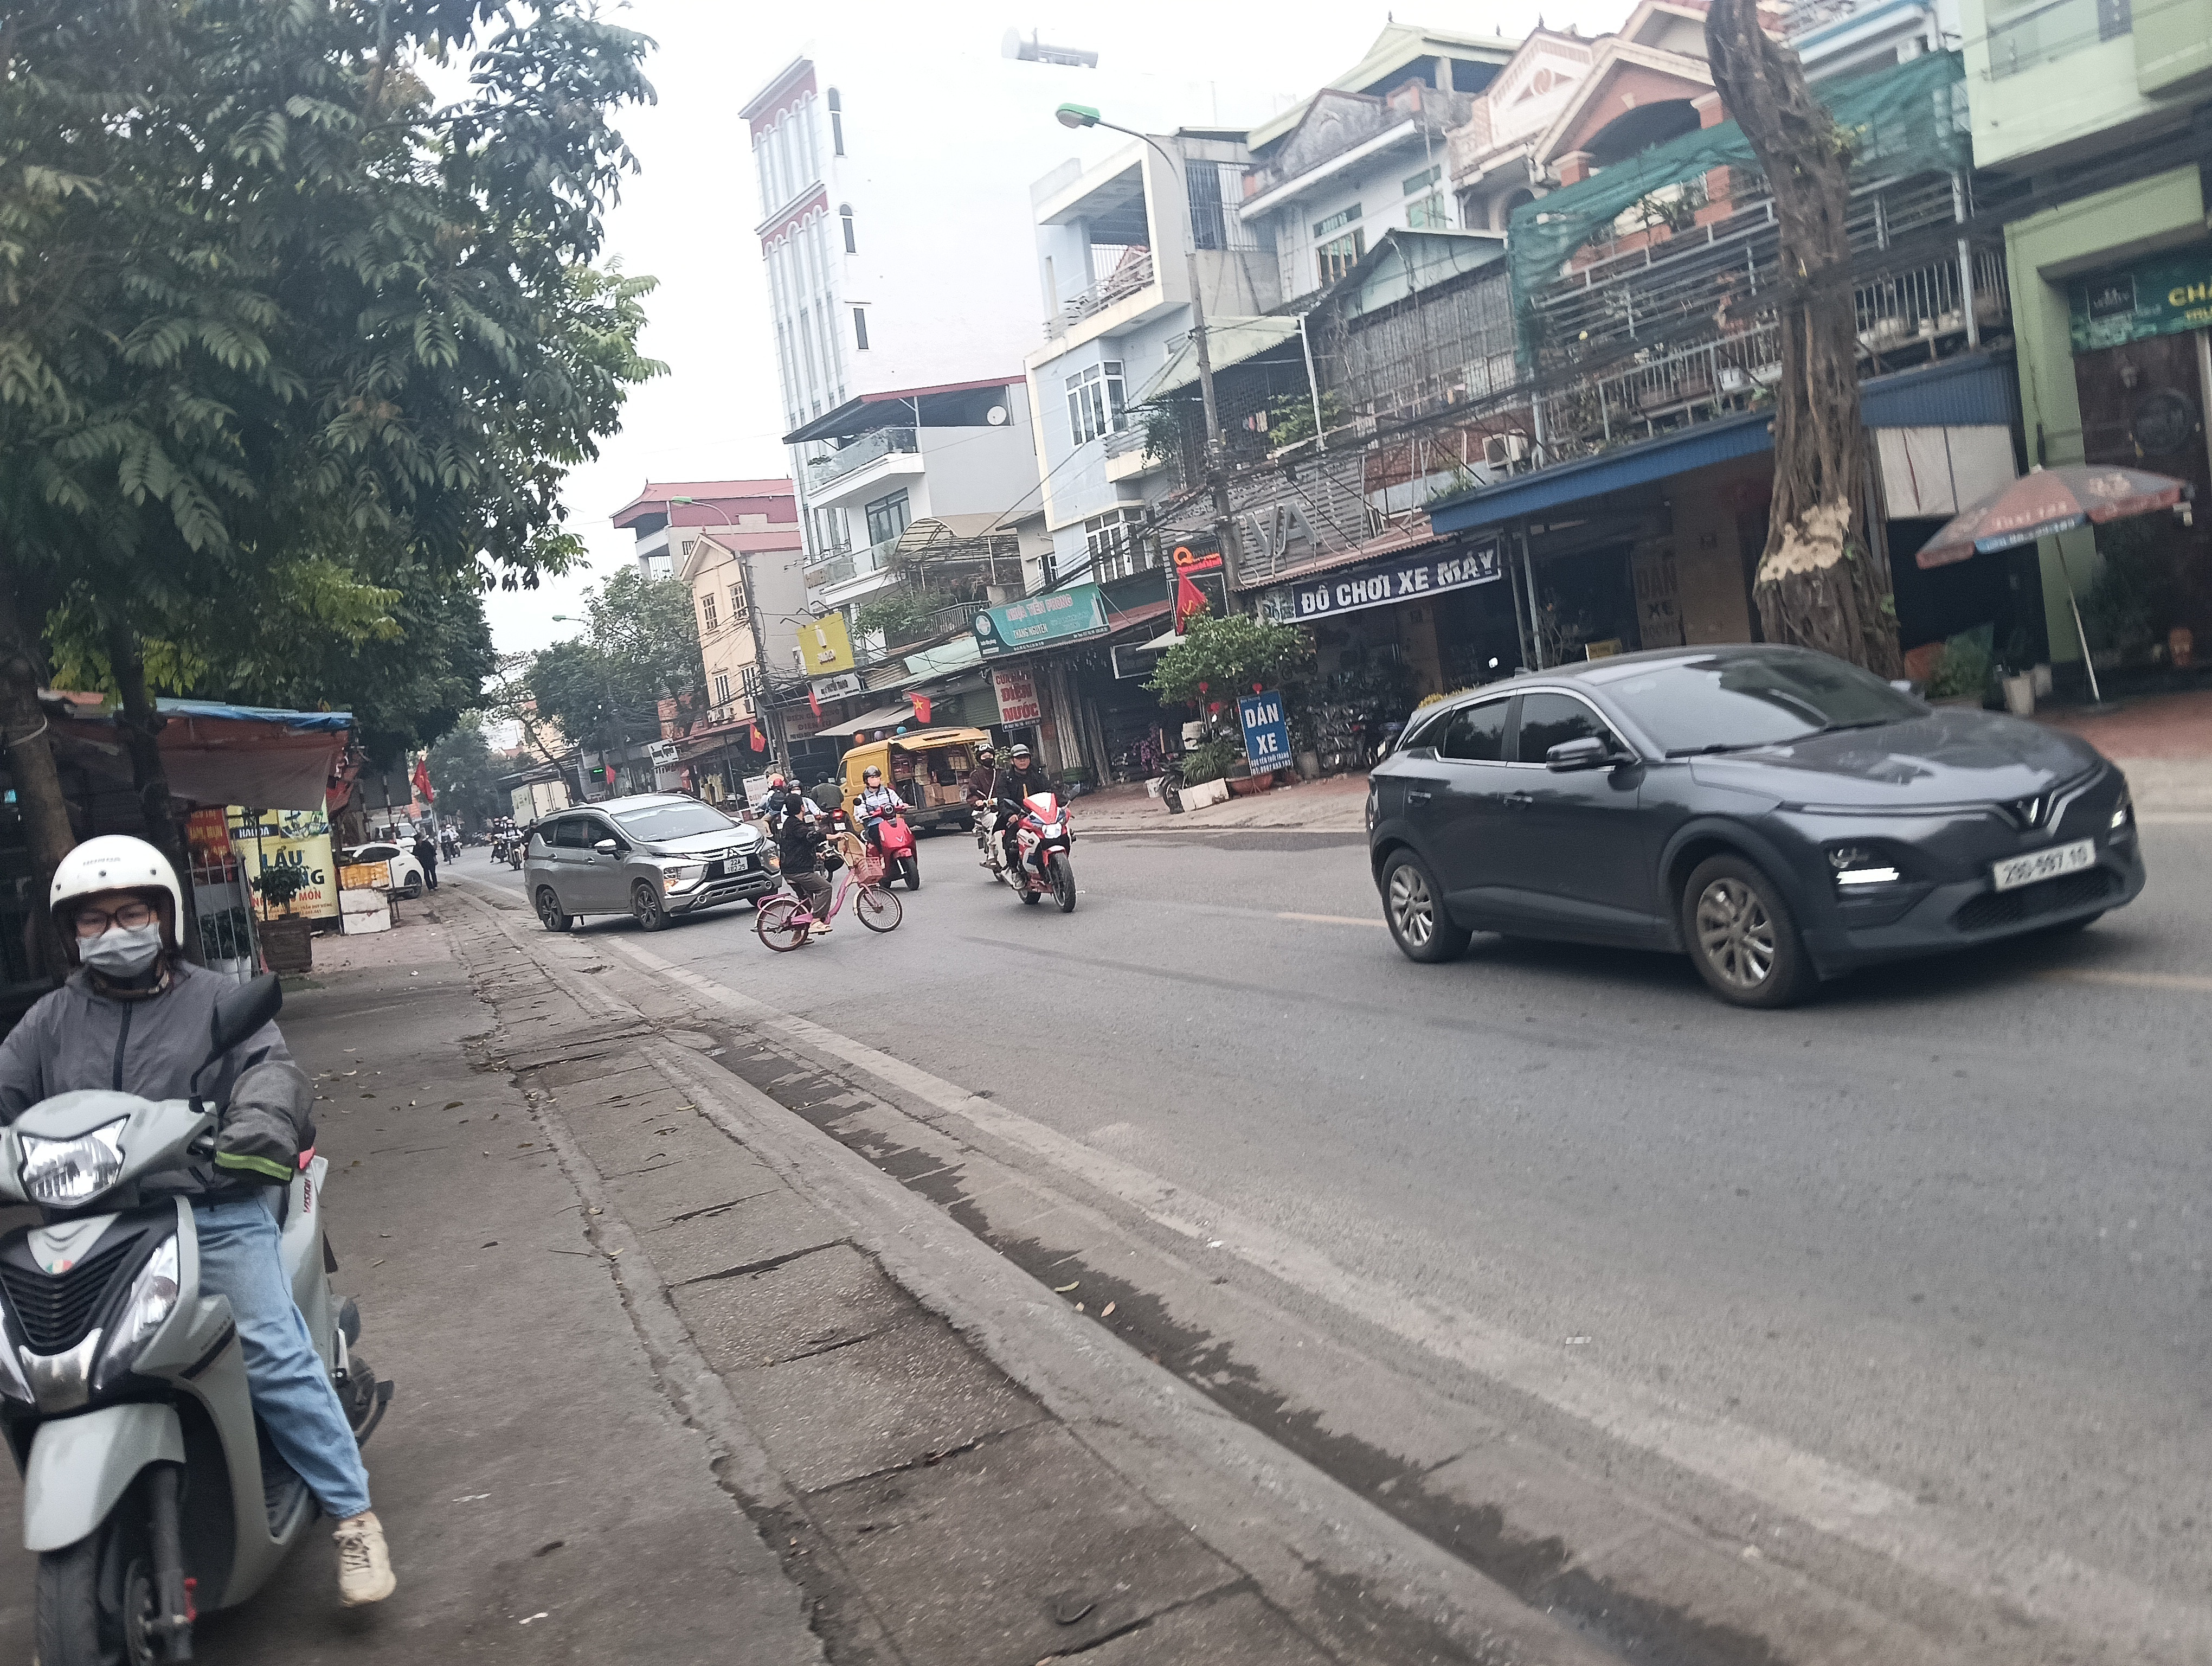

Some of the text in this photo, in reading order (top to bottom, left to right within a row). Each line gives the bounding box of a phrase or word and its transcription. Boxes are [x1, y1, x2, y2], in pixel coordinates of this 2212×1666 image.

[2169, 281, 2212, 307] CH
[1398, 567, 1429, 595] XE
[1045, 593, 1073, 612] PHONG
[1245, 702, 1279, 728] DÁN
[1256, 732, 1278, 755] XE
